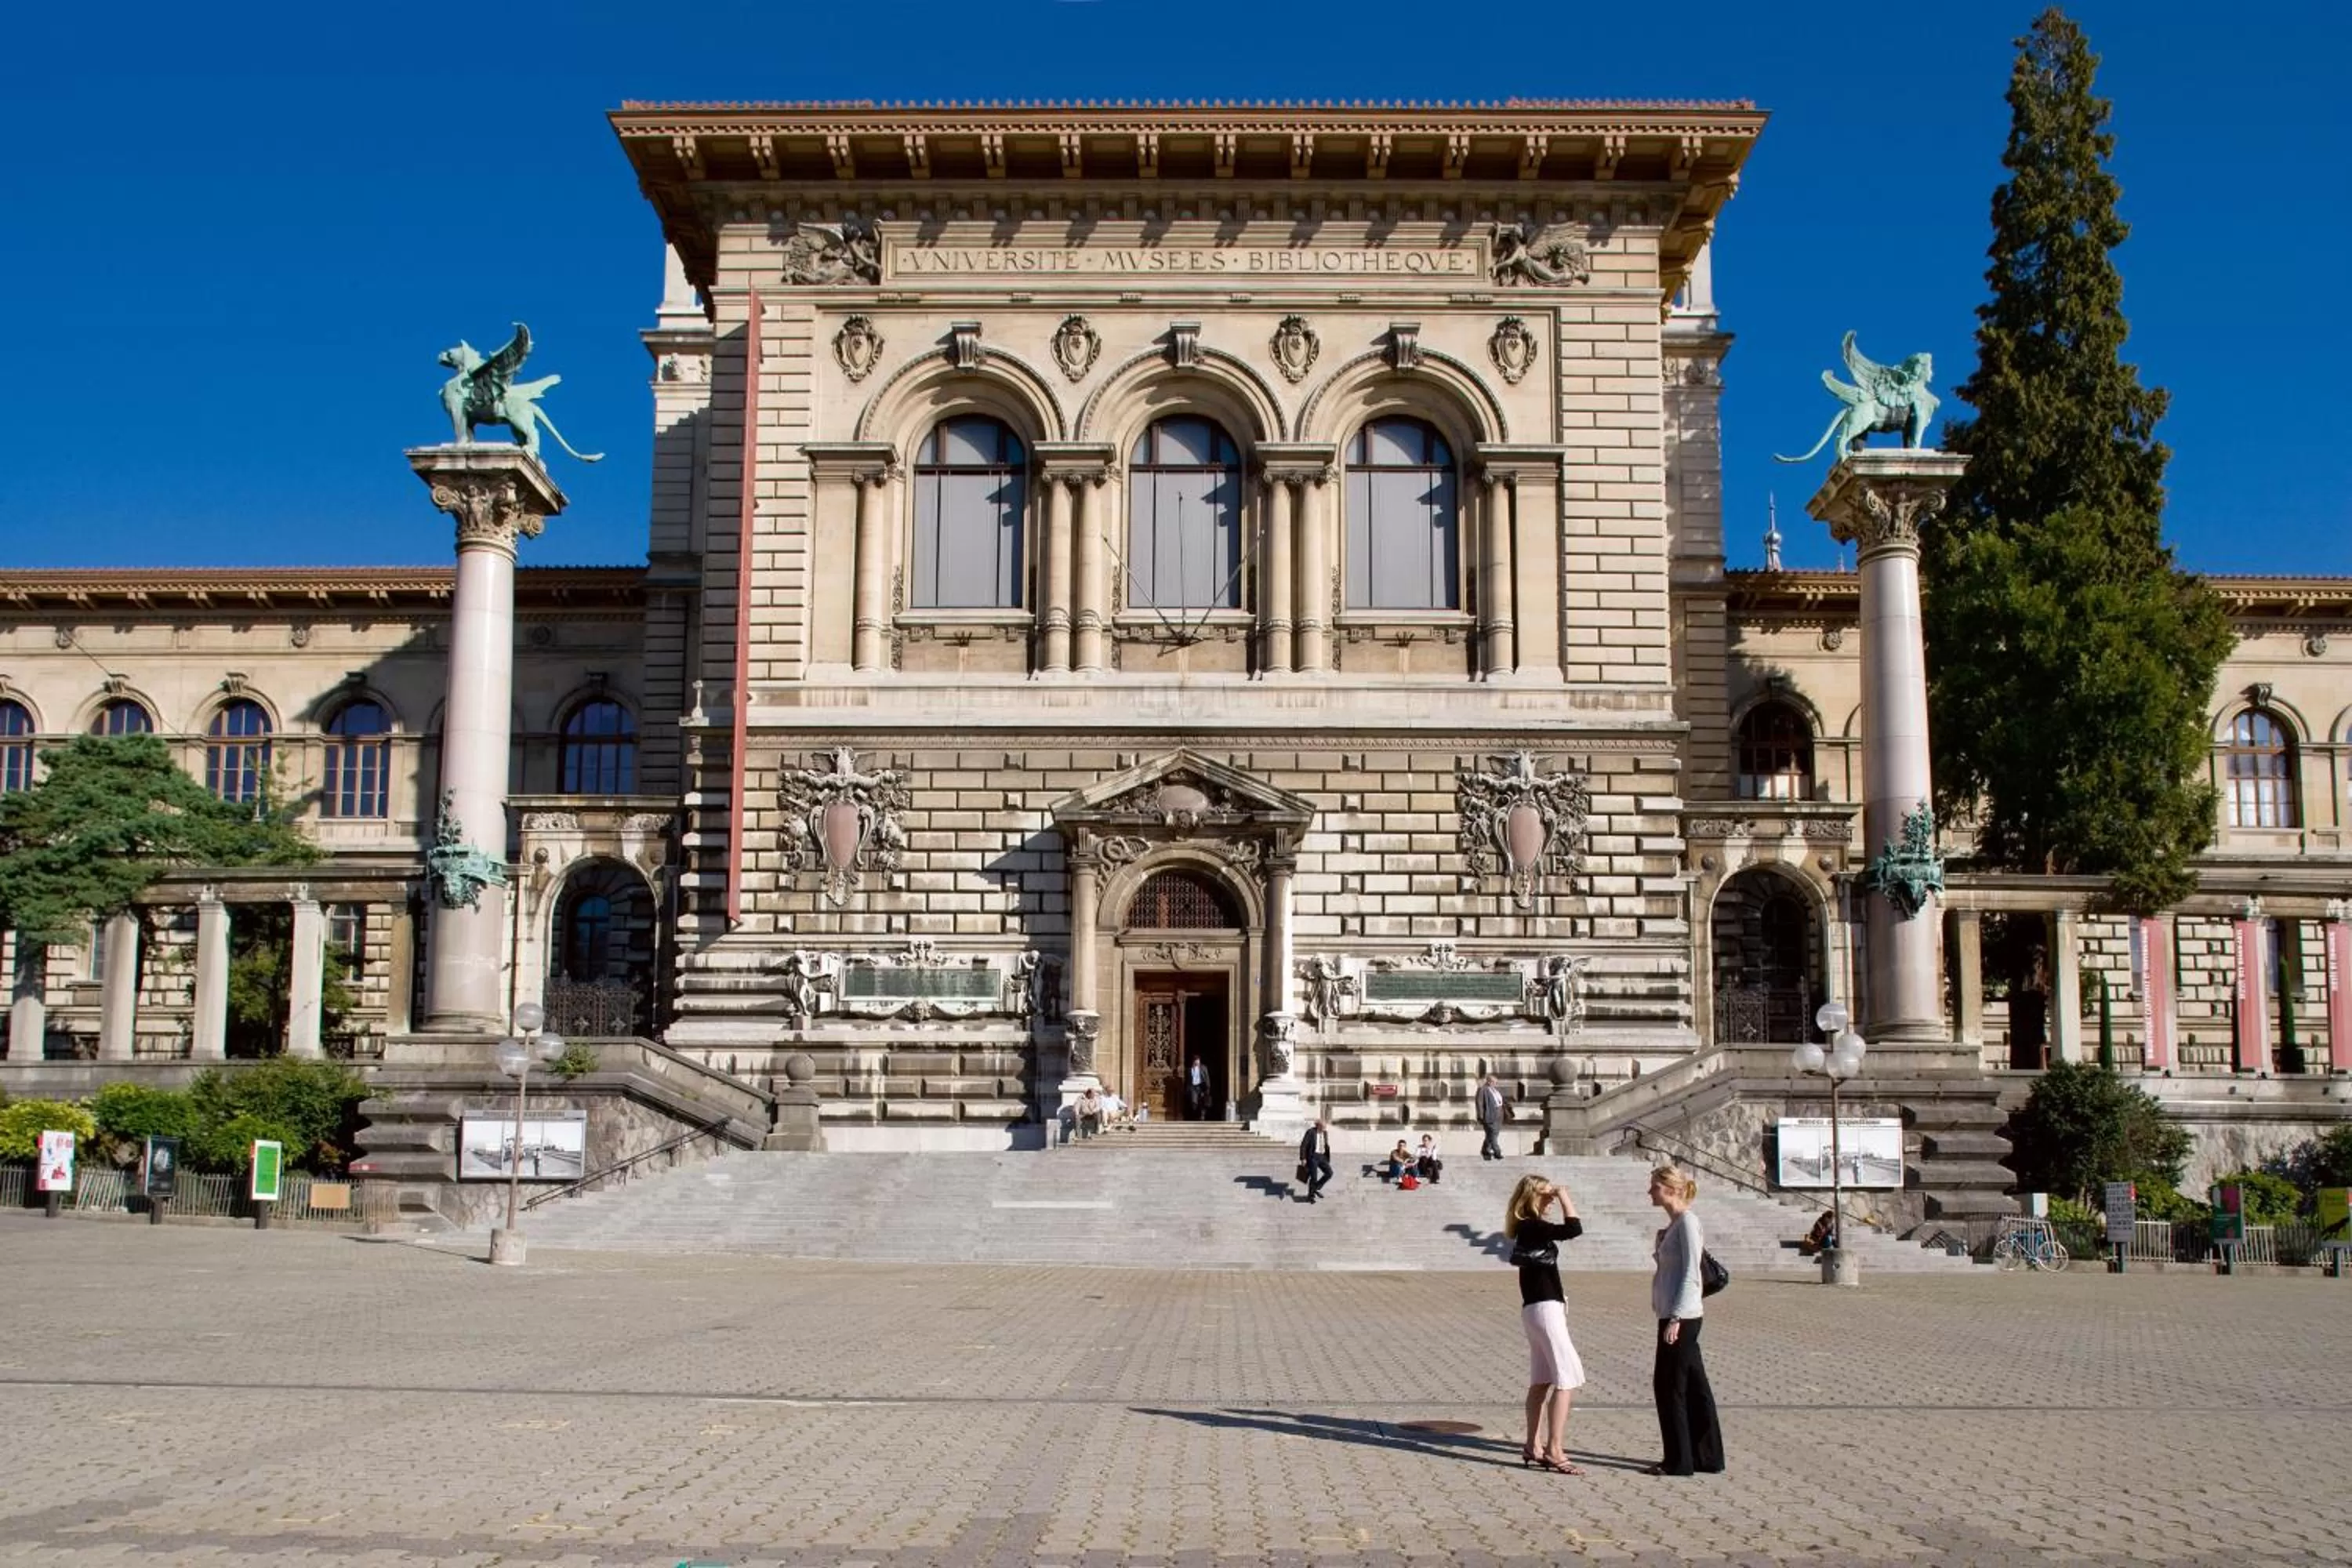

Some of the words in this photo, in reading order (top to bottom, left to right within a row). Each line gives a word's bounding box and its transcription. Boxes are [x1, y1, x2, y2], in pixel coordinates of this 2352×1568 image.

[909, 250, 1080, 270] VNIVERSITE
[1101, 250, 1225, 270] MVSEES
[1248, 251, 1463, 272] BIBLIOTHEQVE
